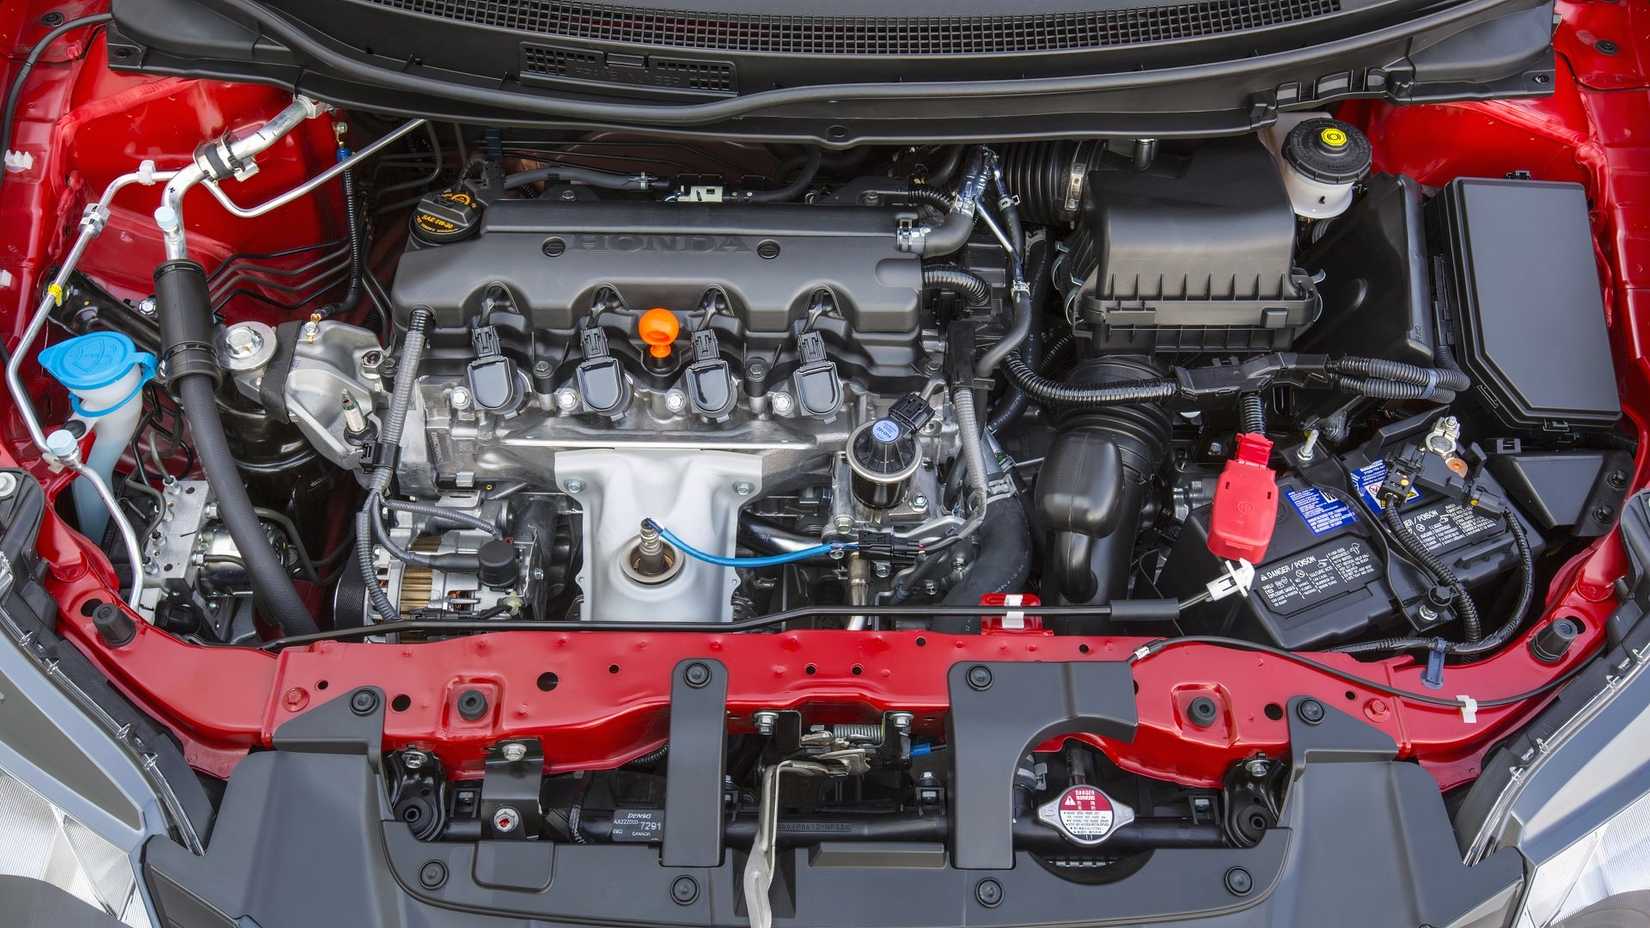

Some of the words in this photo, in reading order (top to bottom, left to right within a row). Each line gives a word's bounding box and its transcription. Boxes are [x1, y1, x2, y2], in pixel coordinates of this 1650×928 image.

[574, 235, 752, 253] HONDA
[1266, 564, 1290, 578] DANGER
[1294, 556, 1317, 569] POISON
[640, 821, 662, 830] 7291
